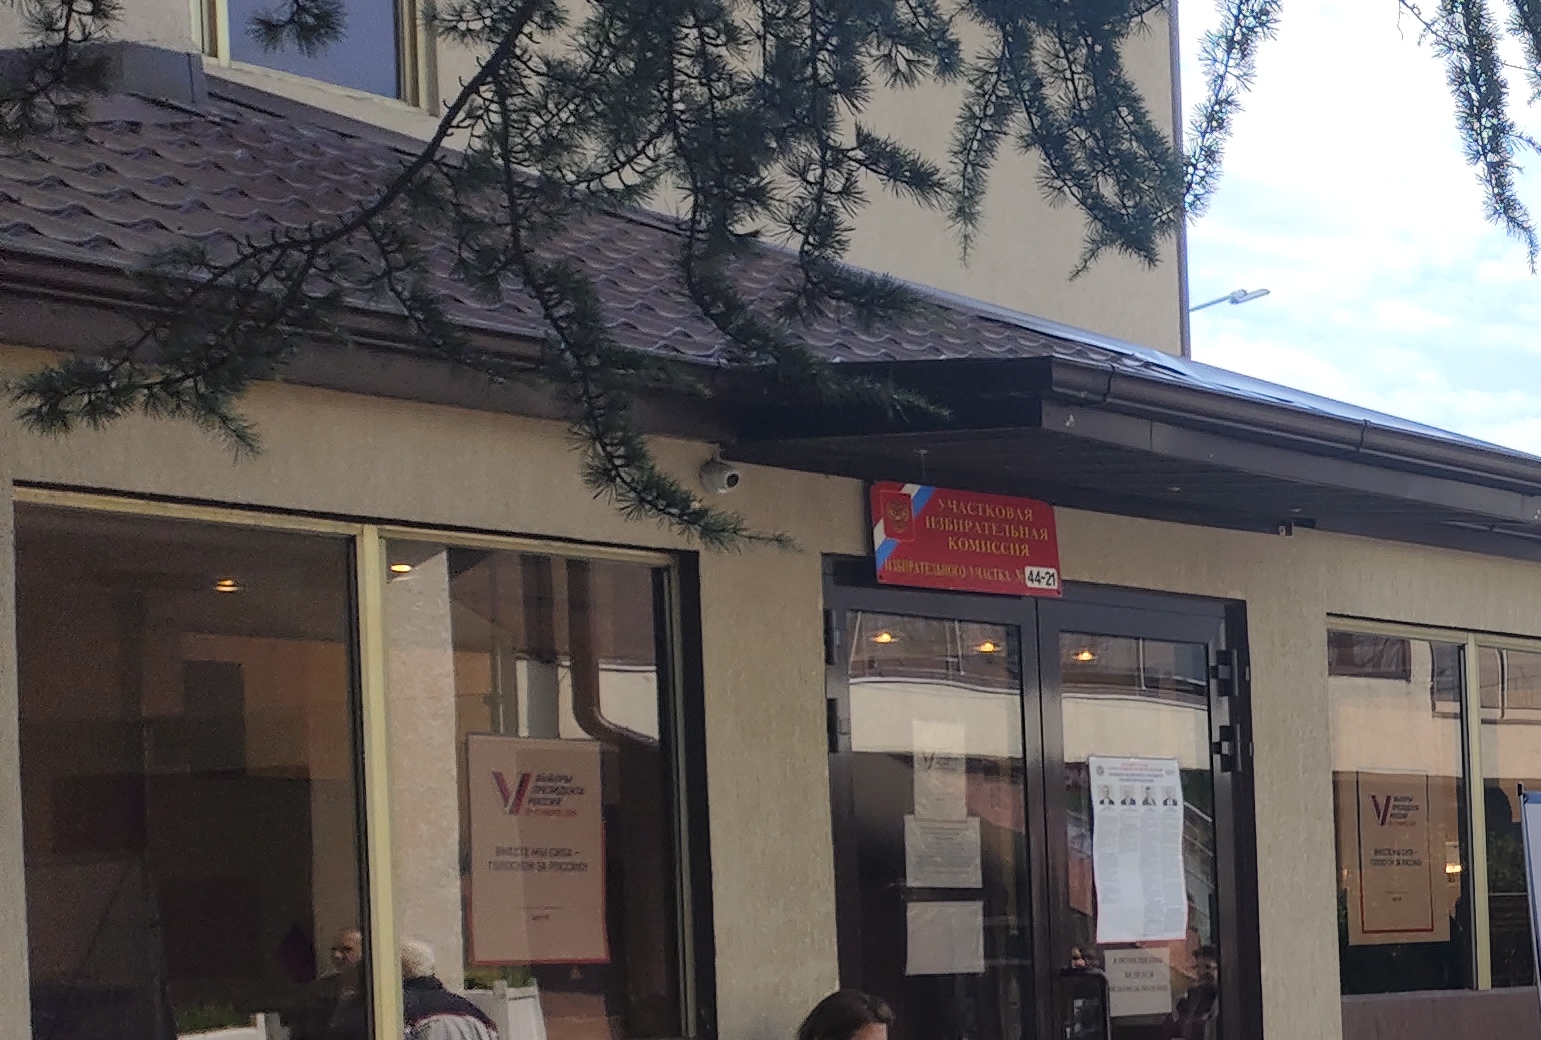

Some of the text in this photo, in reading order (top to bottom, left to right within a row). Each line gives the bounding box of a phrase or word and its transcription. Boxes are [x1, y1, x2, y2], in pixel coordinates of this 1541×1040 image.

[937, 498, 1033, 522] УЧАСТКОВАЯ
[925, 515, 1049, 541] ИЗБИРАТЕЛЬНАЯ
[948, 536, 1030, 557] КОМИССИЯ
[1027, 570, 1056, 586] 44-21
